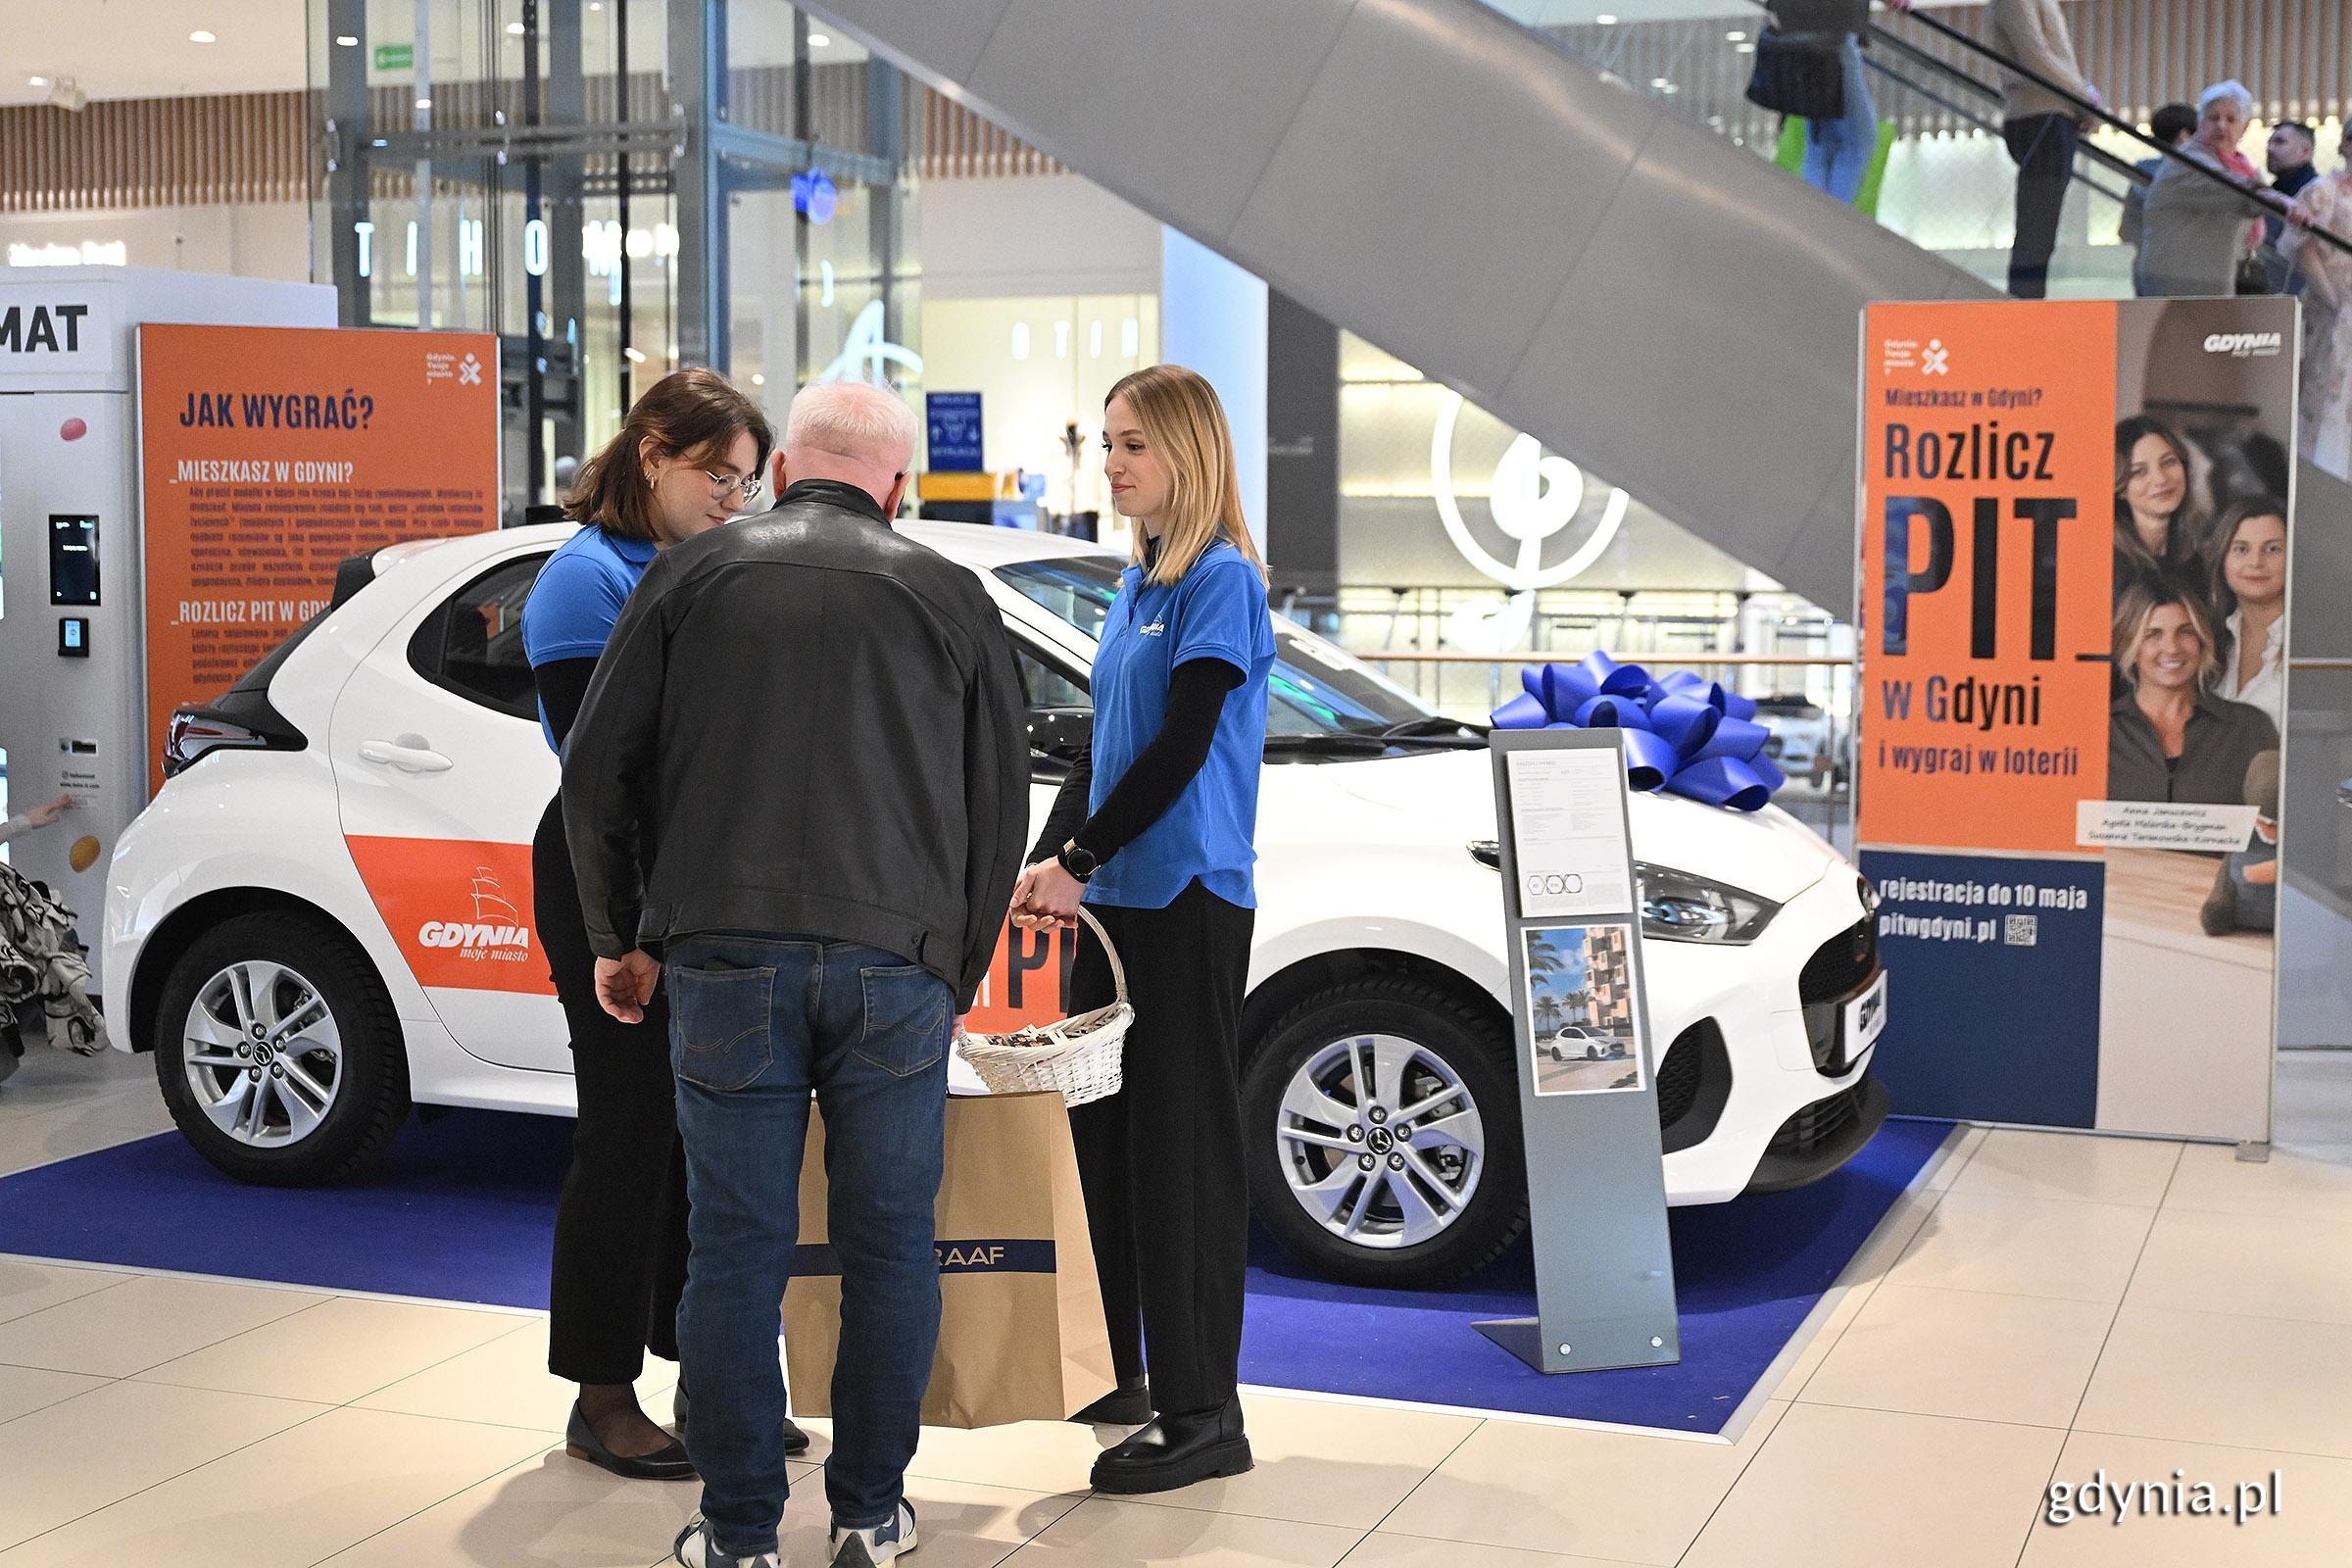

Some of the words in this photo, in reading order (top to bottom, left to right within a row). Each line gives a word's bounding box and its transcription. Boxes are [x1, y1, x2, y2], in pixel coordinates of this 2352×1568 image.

[2203, 332, 2281, 353] GDYNIA
[179, 392, 234, 428] JAK
[242, 388, 374, 429] WYGRAĆ?
[1885, 387, 1966, 407] Mieszkasz
[1972, 391, 1983, 407] w
[1987, 386, 2042, 410] Gdyni?
[1885, 420, 2055, 480] Rozlicz
[274, 461, 290, 484] W
[294, 461, 354, 485] GDYNI?
[250, 600, 276, 623] PIT
[279, 600, 294, 622] W
[1882, 679, 1913, 721] w
[1926, 674, 2040, 731] Gdyni
[1878, 739, 1886, 768] i
[1891, 742, 1973, 775] wygraj
[1978, 749, 1997, 773] w
[2003, 745, 2079, 776] loterii
[1879, 876, 1985, 906] rejestracja
[1987, 882, 2012, 906] do
[2014, 883, 2036, 907] 10
[2038, 885, 2088, 911] maja
[417, 920, 529, 950] GDYNIA
[1878, 911, 1997, 944] pitwgdyni.pl
[459, 947, 489, 962] moje
[490, 948, 529, 962] miasto
